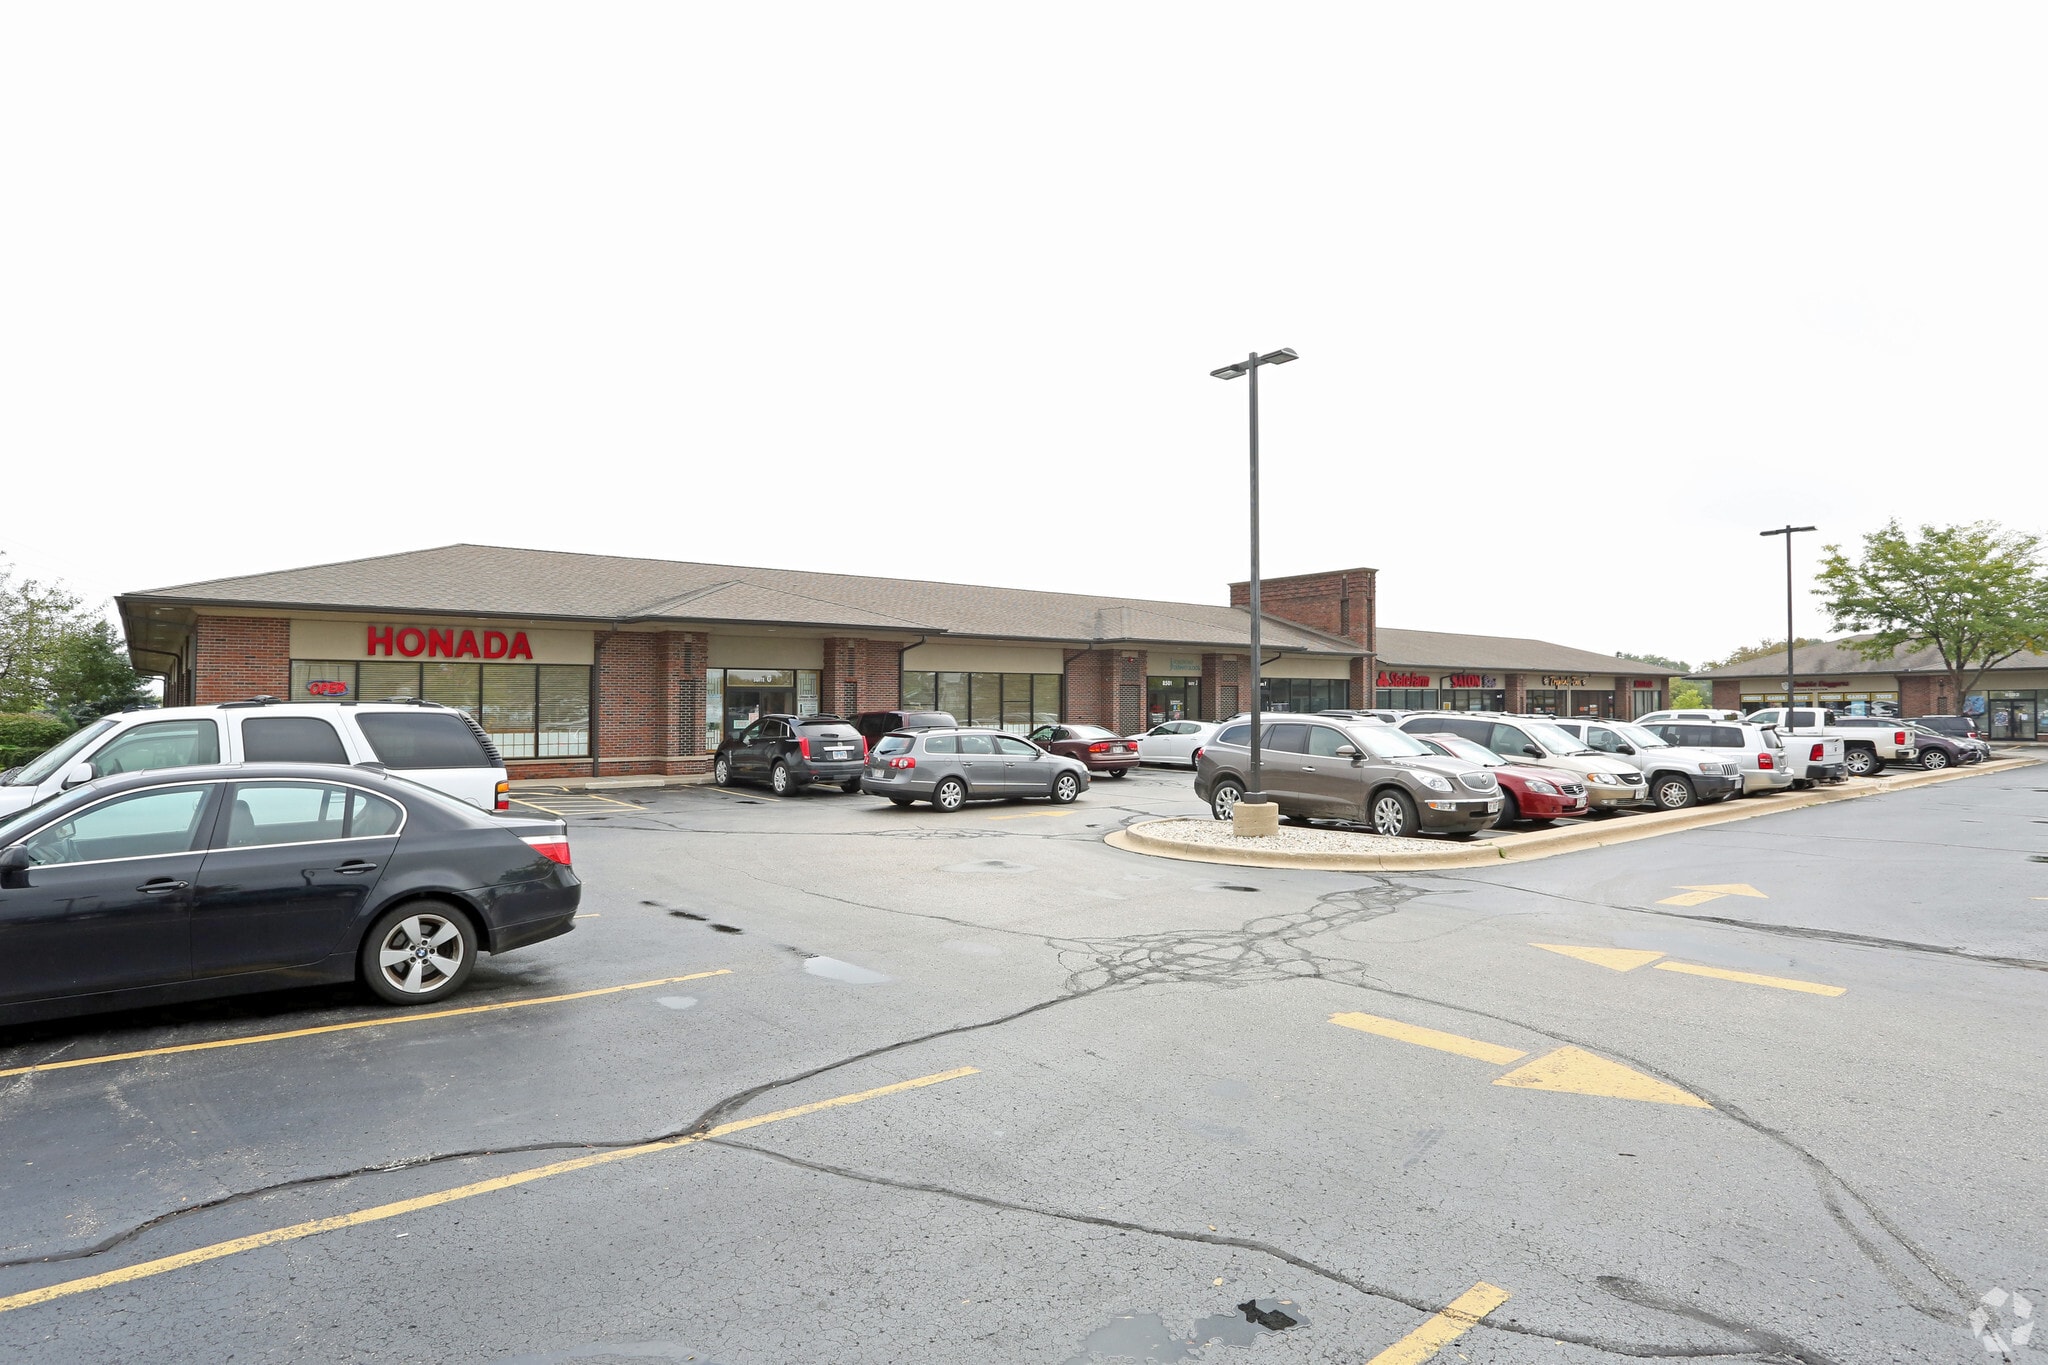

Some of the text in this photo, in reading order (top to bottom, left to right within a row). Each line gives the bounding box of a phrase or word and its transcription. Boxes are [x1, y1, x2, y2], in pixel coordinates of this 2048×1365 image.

[367, 626, 533, 660] HONADA
[310, 681, 346, 695] OPEN
[1450, 674, 1481, 688] SALON
